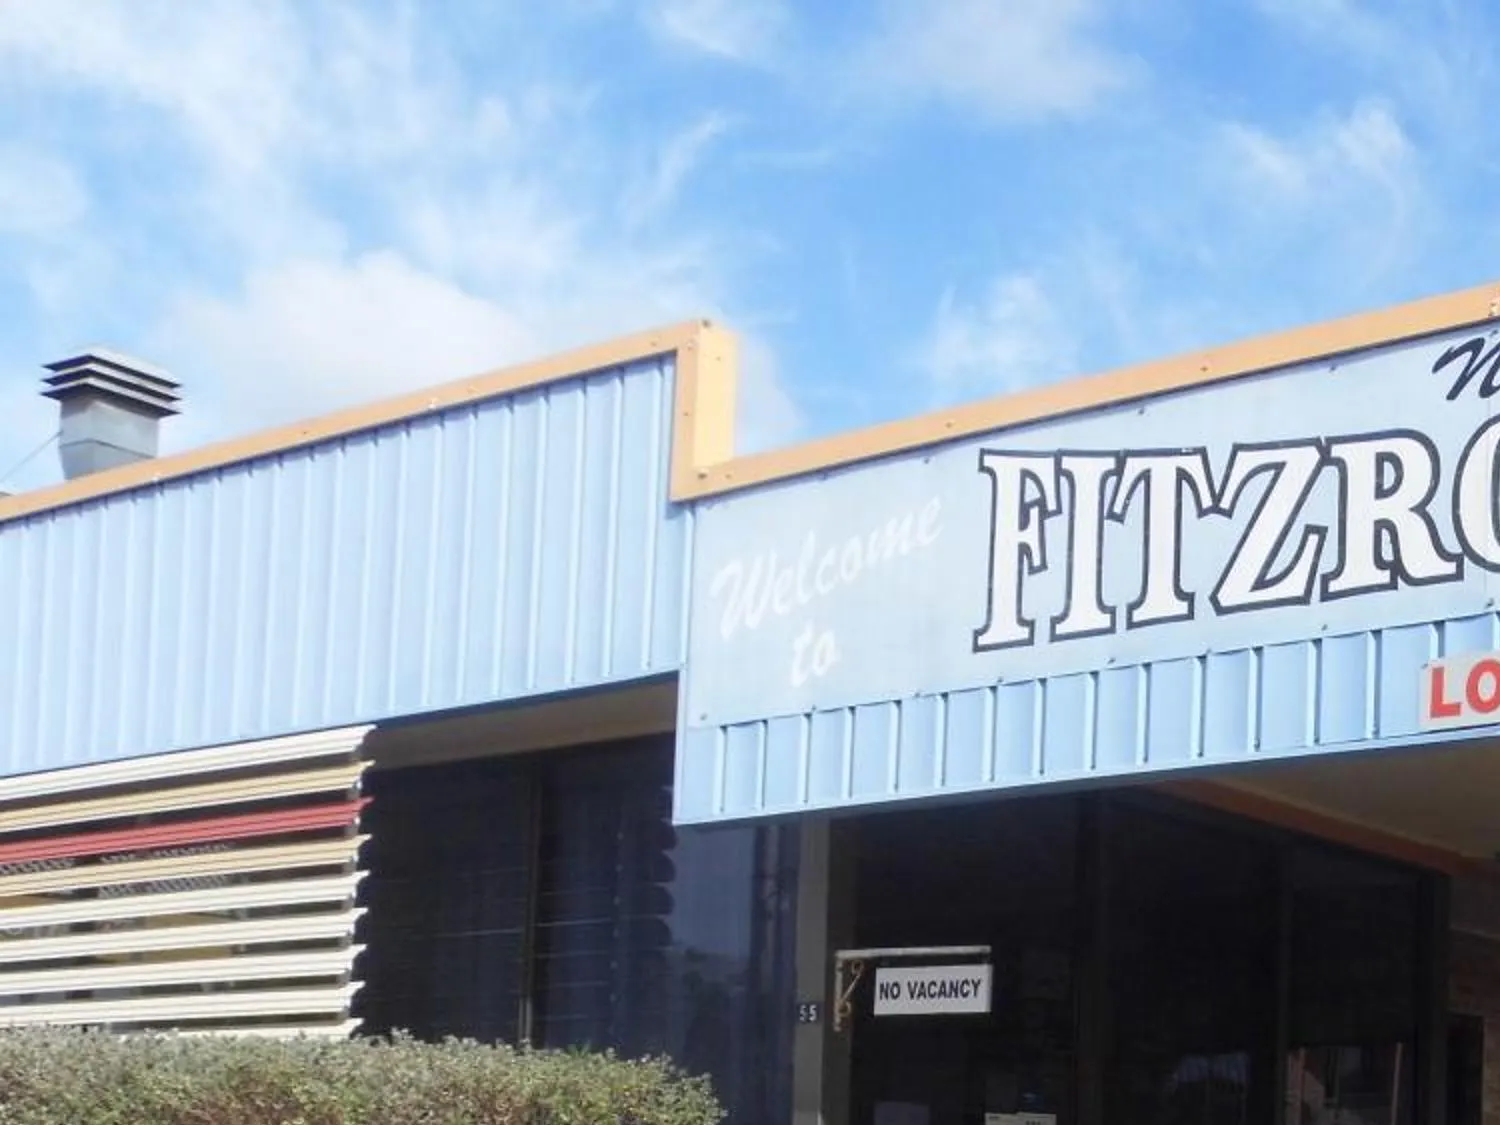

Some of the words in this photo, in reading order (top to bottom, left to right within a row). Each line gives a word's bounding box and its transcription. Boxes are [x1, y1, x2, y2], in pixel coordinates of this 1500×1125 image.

[708, 496, 943, 642] Welcome
[790, 618, 842, 688] to
[879, 981, 901, 1000] NO
[907, 978, 982, 1000] VACANCY
